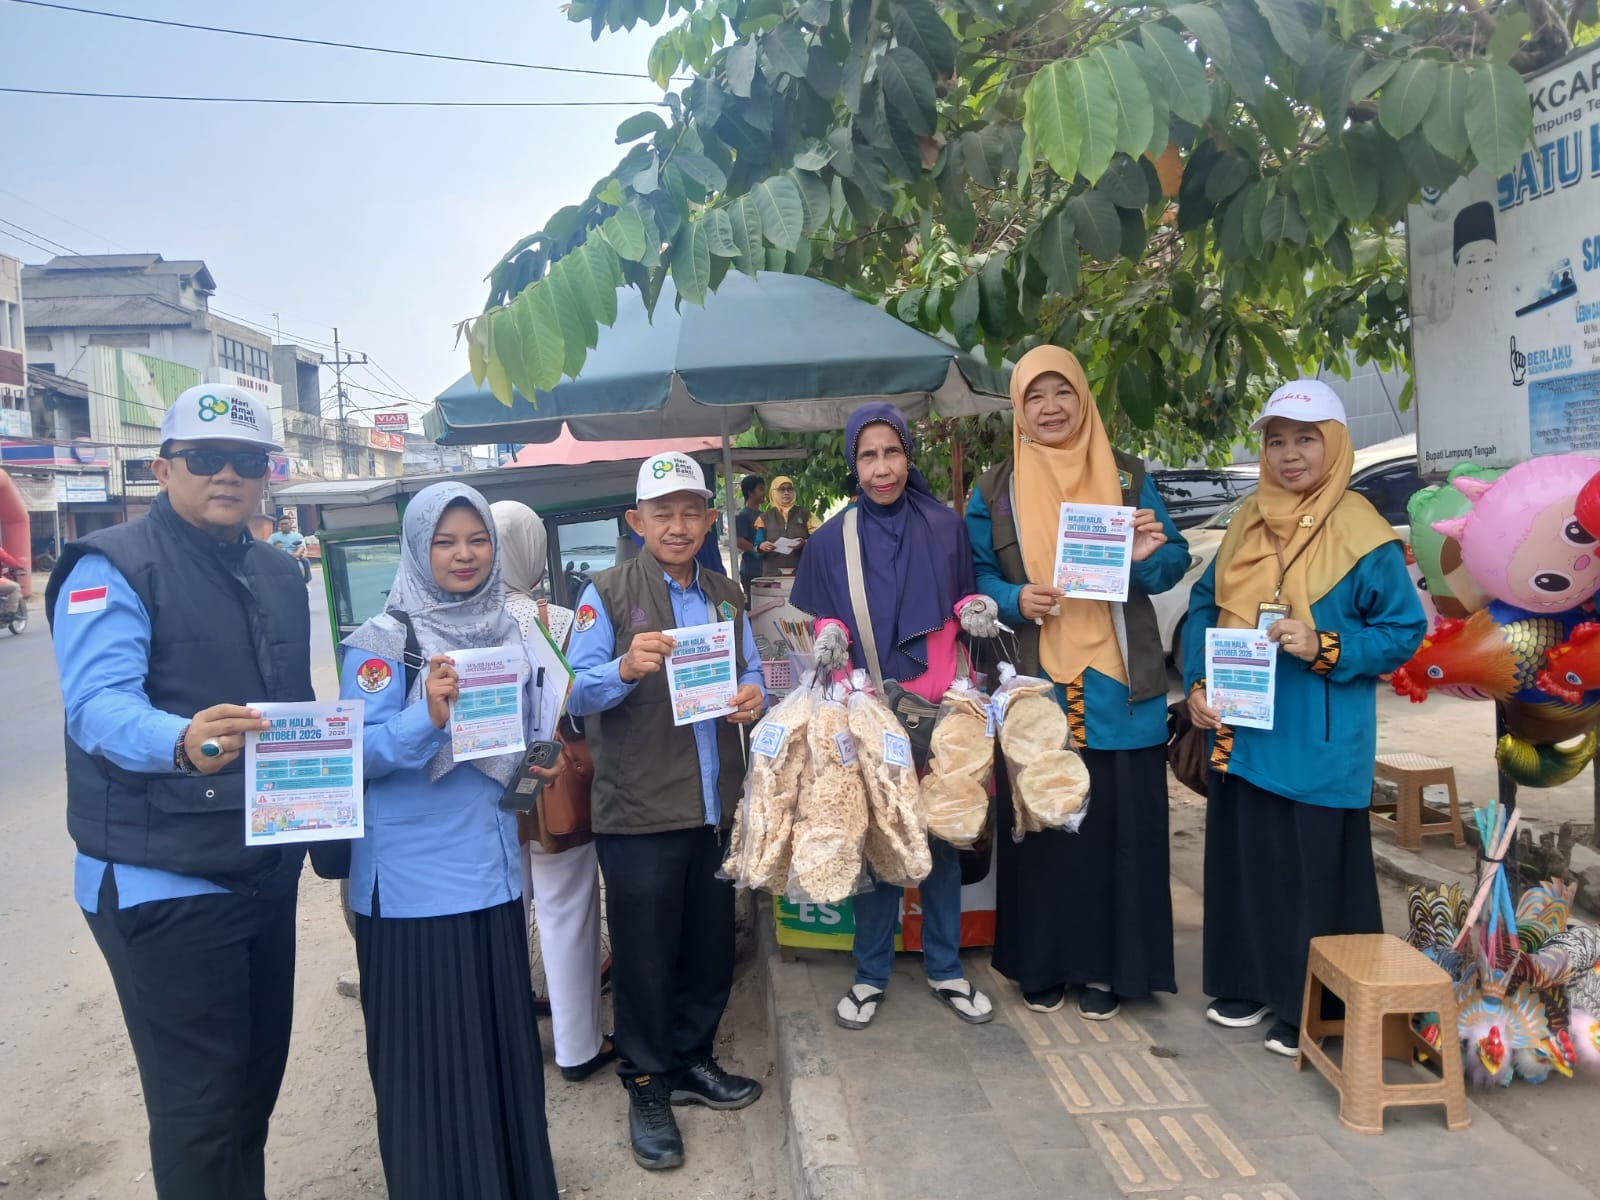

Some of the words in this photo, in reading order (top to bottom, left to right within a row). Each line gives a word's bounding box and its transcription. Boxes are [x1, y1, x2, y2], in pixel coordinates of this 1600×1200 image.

[1497, 130, 1582, 211] SATU
[1528, 344, 1571, 366] BERLAKU
[232, 398, 248, 408] Hari
[231, 405, 253, 416] Amal
[231, 412, 256, 424] Bakti
[1426, 449, 1443, 461] Bupati
[1445, 448, 1472, 459] Lampung
[1474, 444, 1497, 457] Tengah
[269, 719, 287, 728] AJIB
[259, 730, 296, 742] OKTOBER
[299, 729, 322, 739] 2026
[800, 902, 841, 925] ES
